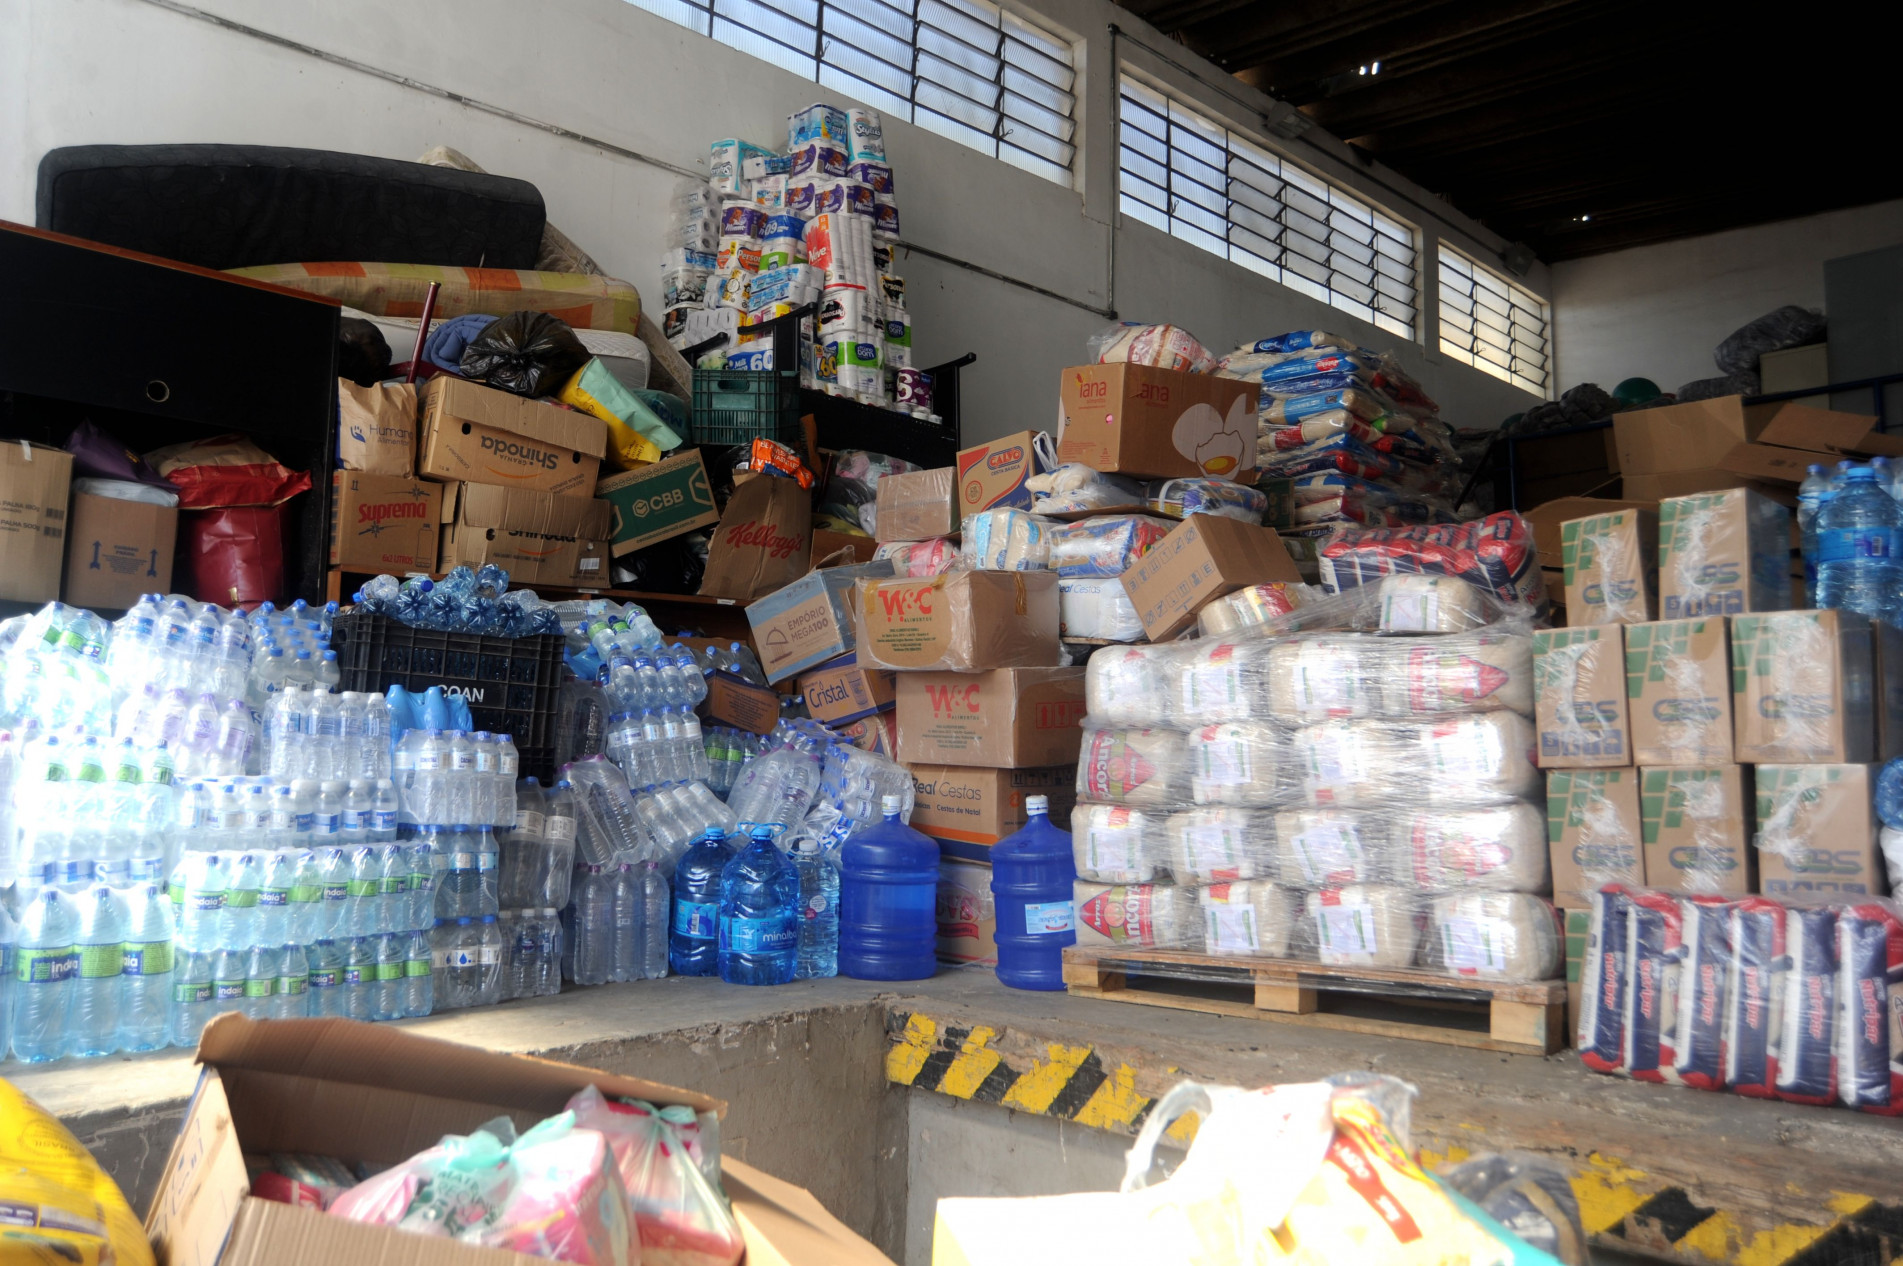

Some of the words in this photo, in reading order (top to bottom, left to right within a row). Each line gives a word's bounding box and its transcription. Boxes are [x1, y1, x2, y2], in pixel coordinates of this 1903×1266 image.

[480, 435, 559, 470] Shinoda
[989, 449, 1021, 467] CALVO
[650, 488, 684, 510] CBB
[358, 502, 428, 524] Suprema
[1074, 584, 1101, 594] Cestas
[878, 587, 933, 617] W&C
[787, 606, 826, 631] EMPÓRIO
[791, 618, 829, 643] MEGA100
[809, 679, 850, 708] Cristal
[925, 684, 980, 714] W&C
[939, 782, 982, 800] Cestas
[937, 804, 952, 813] Cestas
[956, 806, 964, 814] de
[965, 807, 981, 816] Natal
